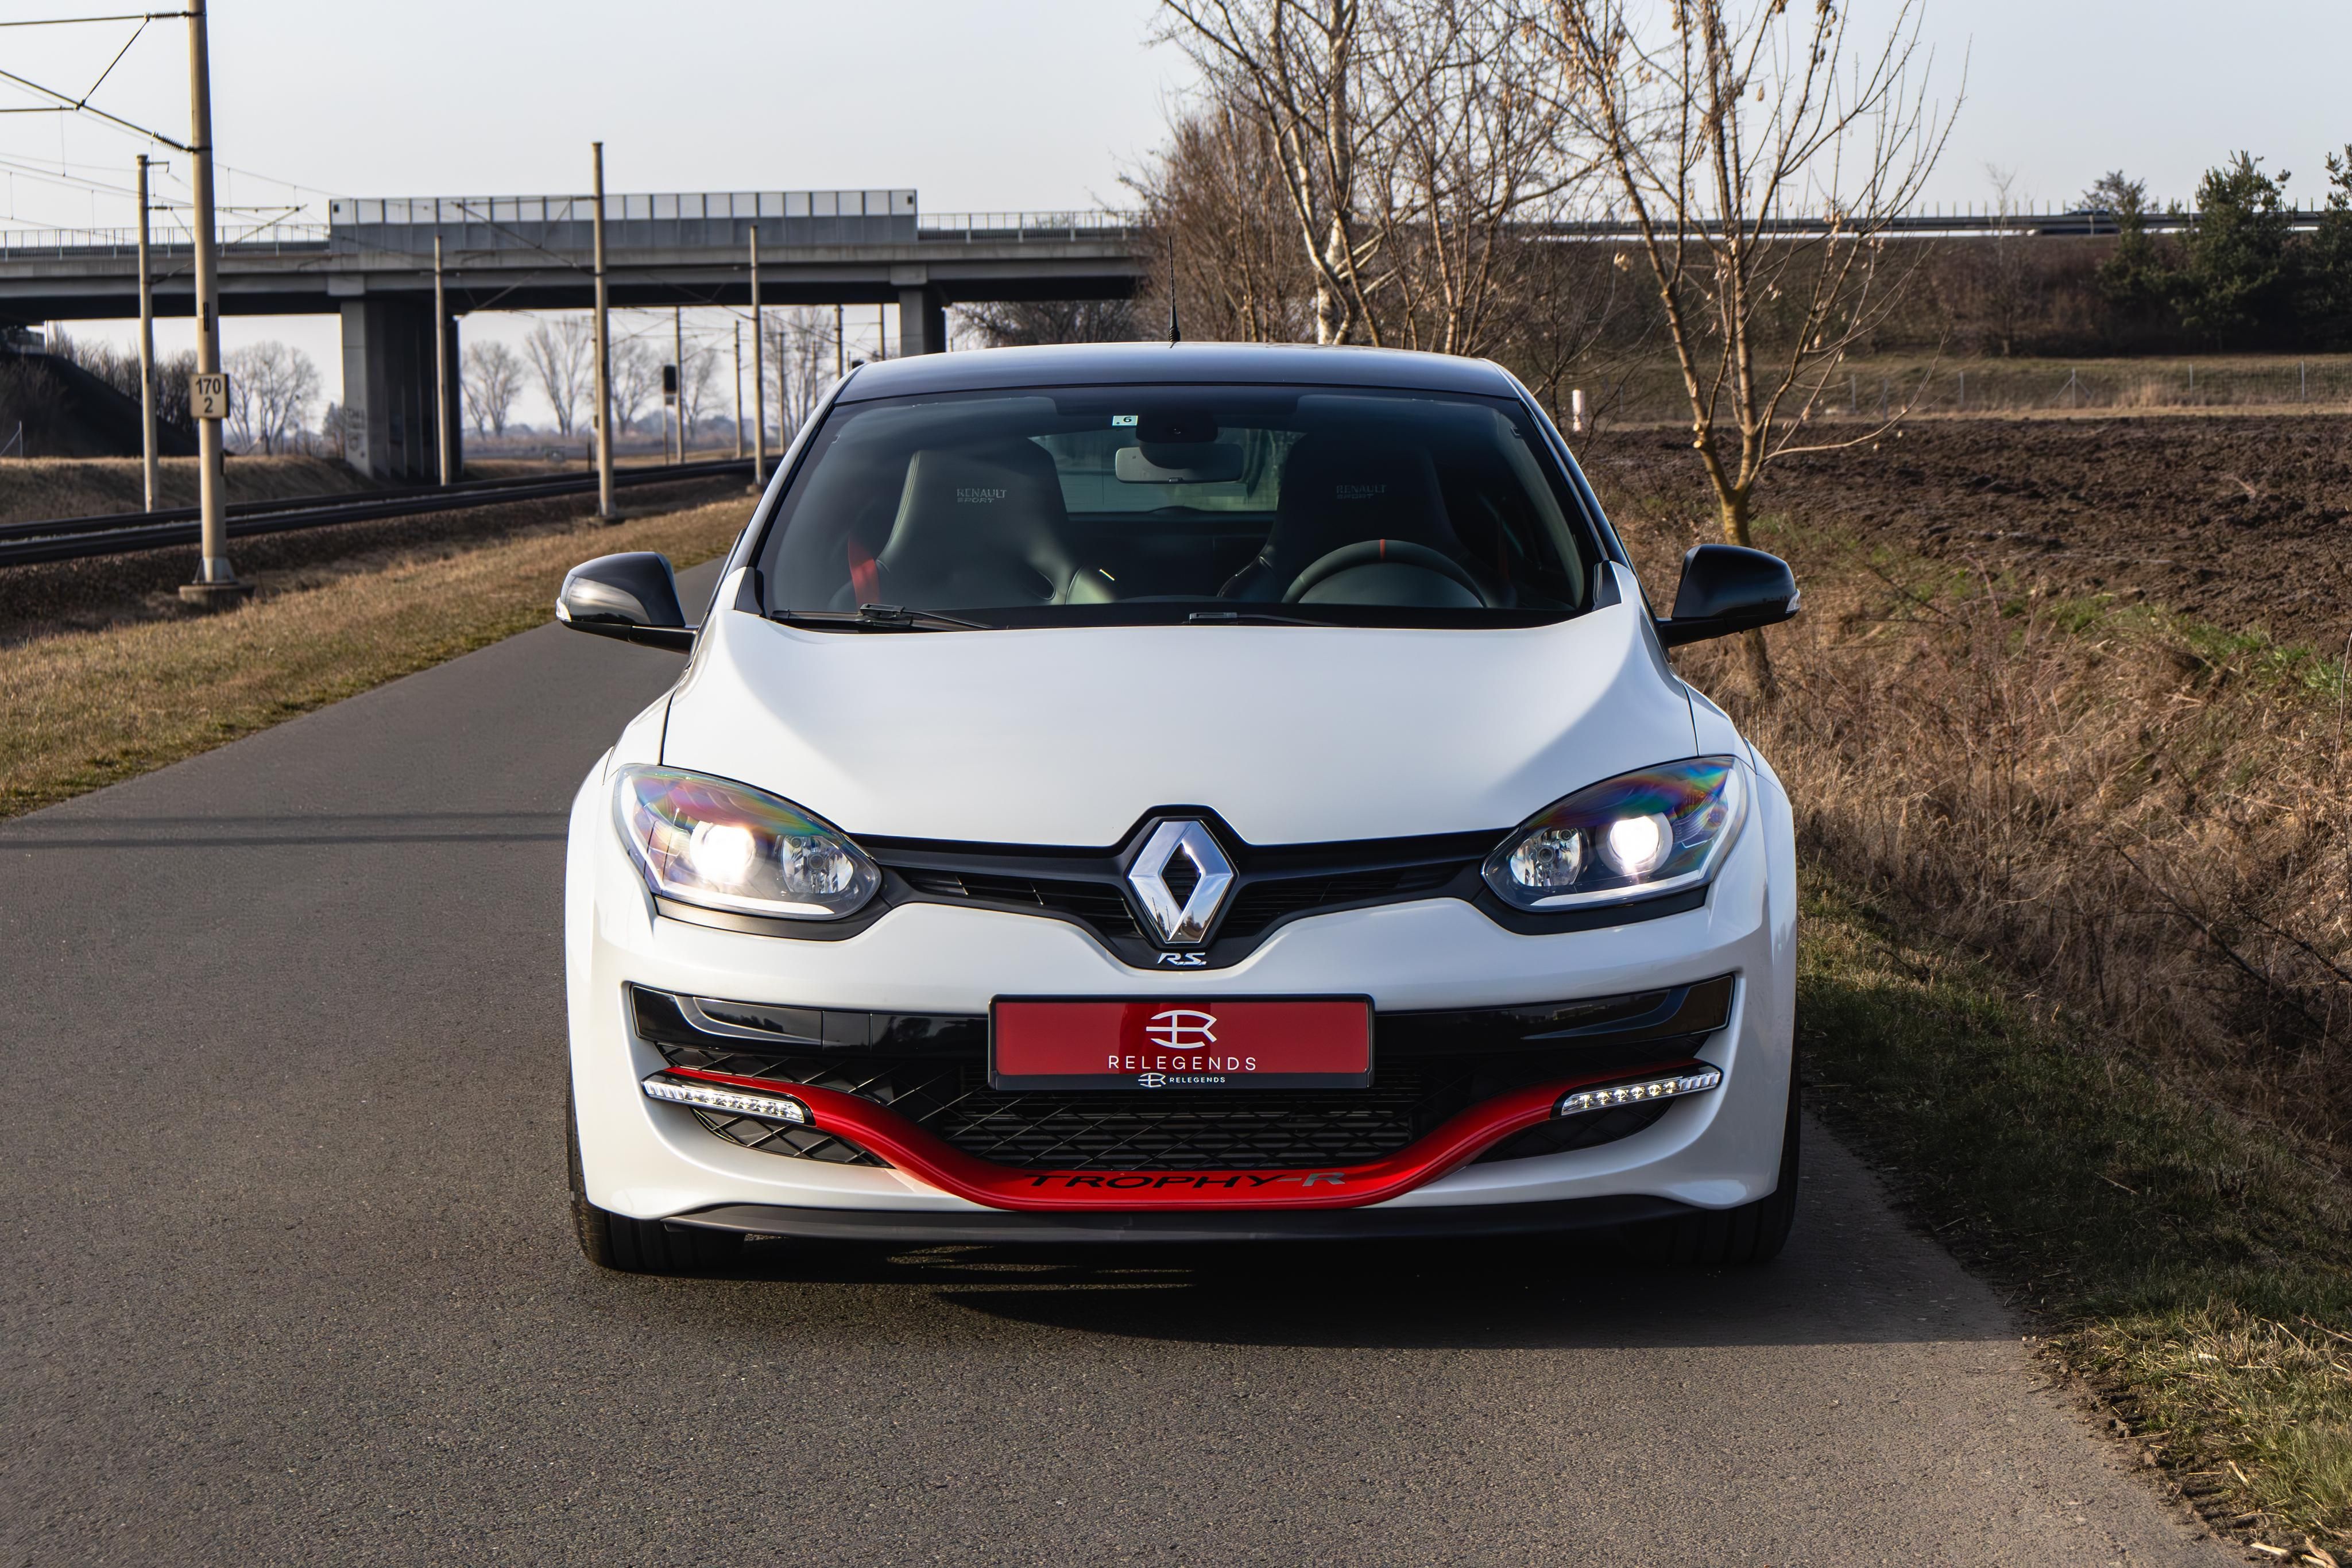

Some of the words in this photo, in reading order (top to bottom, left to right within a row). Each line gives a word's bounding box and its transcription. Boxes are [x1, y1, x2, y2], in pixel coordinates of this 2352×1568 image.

[195, 378, 222, 395] 170
[204, 396, 213, 413] 2
[957, 488, 1007, 498] RENAULT
[1108, 1055, 1256, 1071] RELEGENDS
[1024, 1172, 1346, 1189] TROPHY-R
